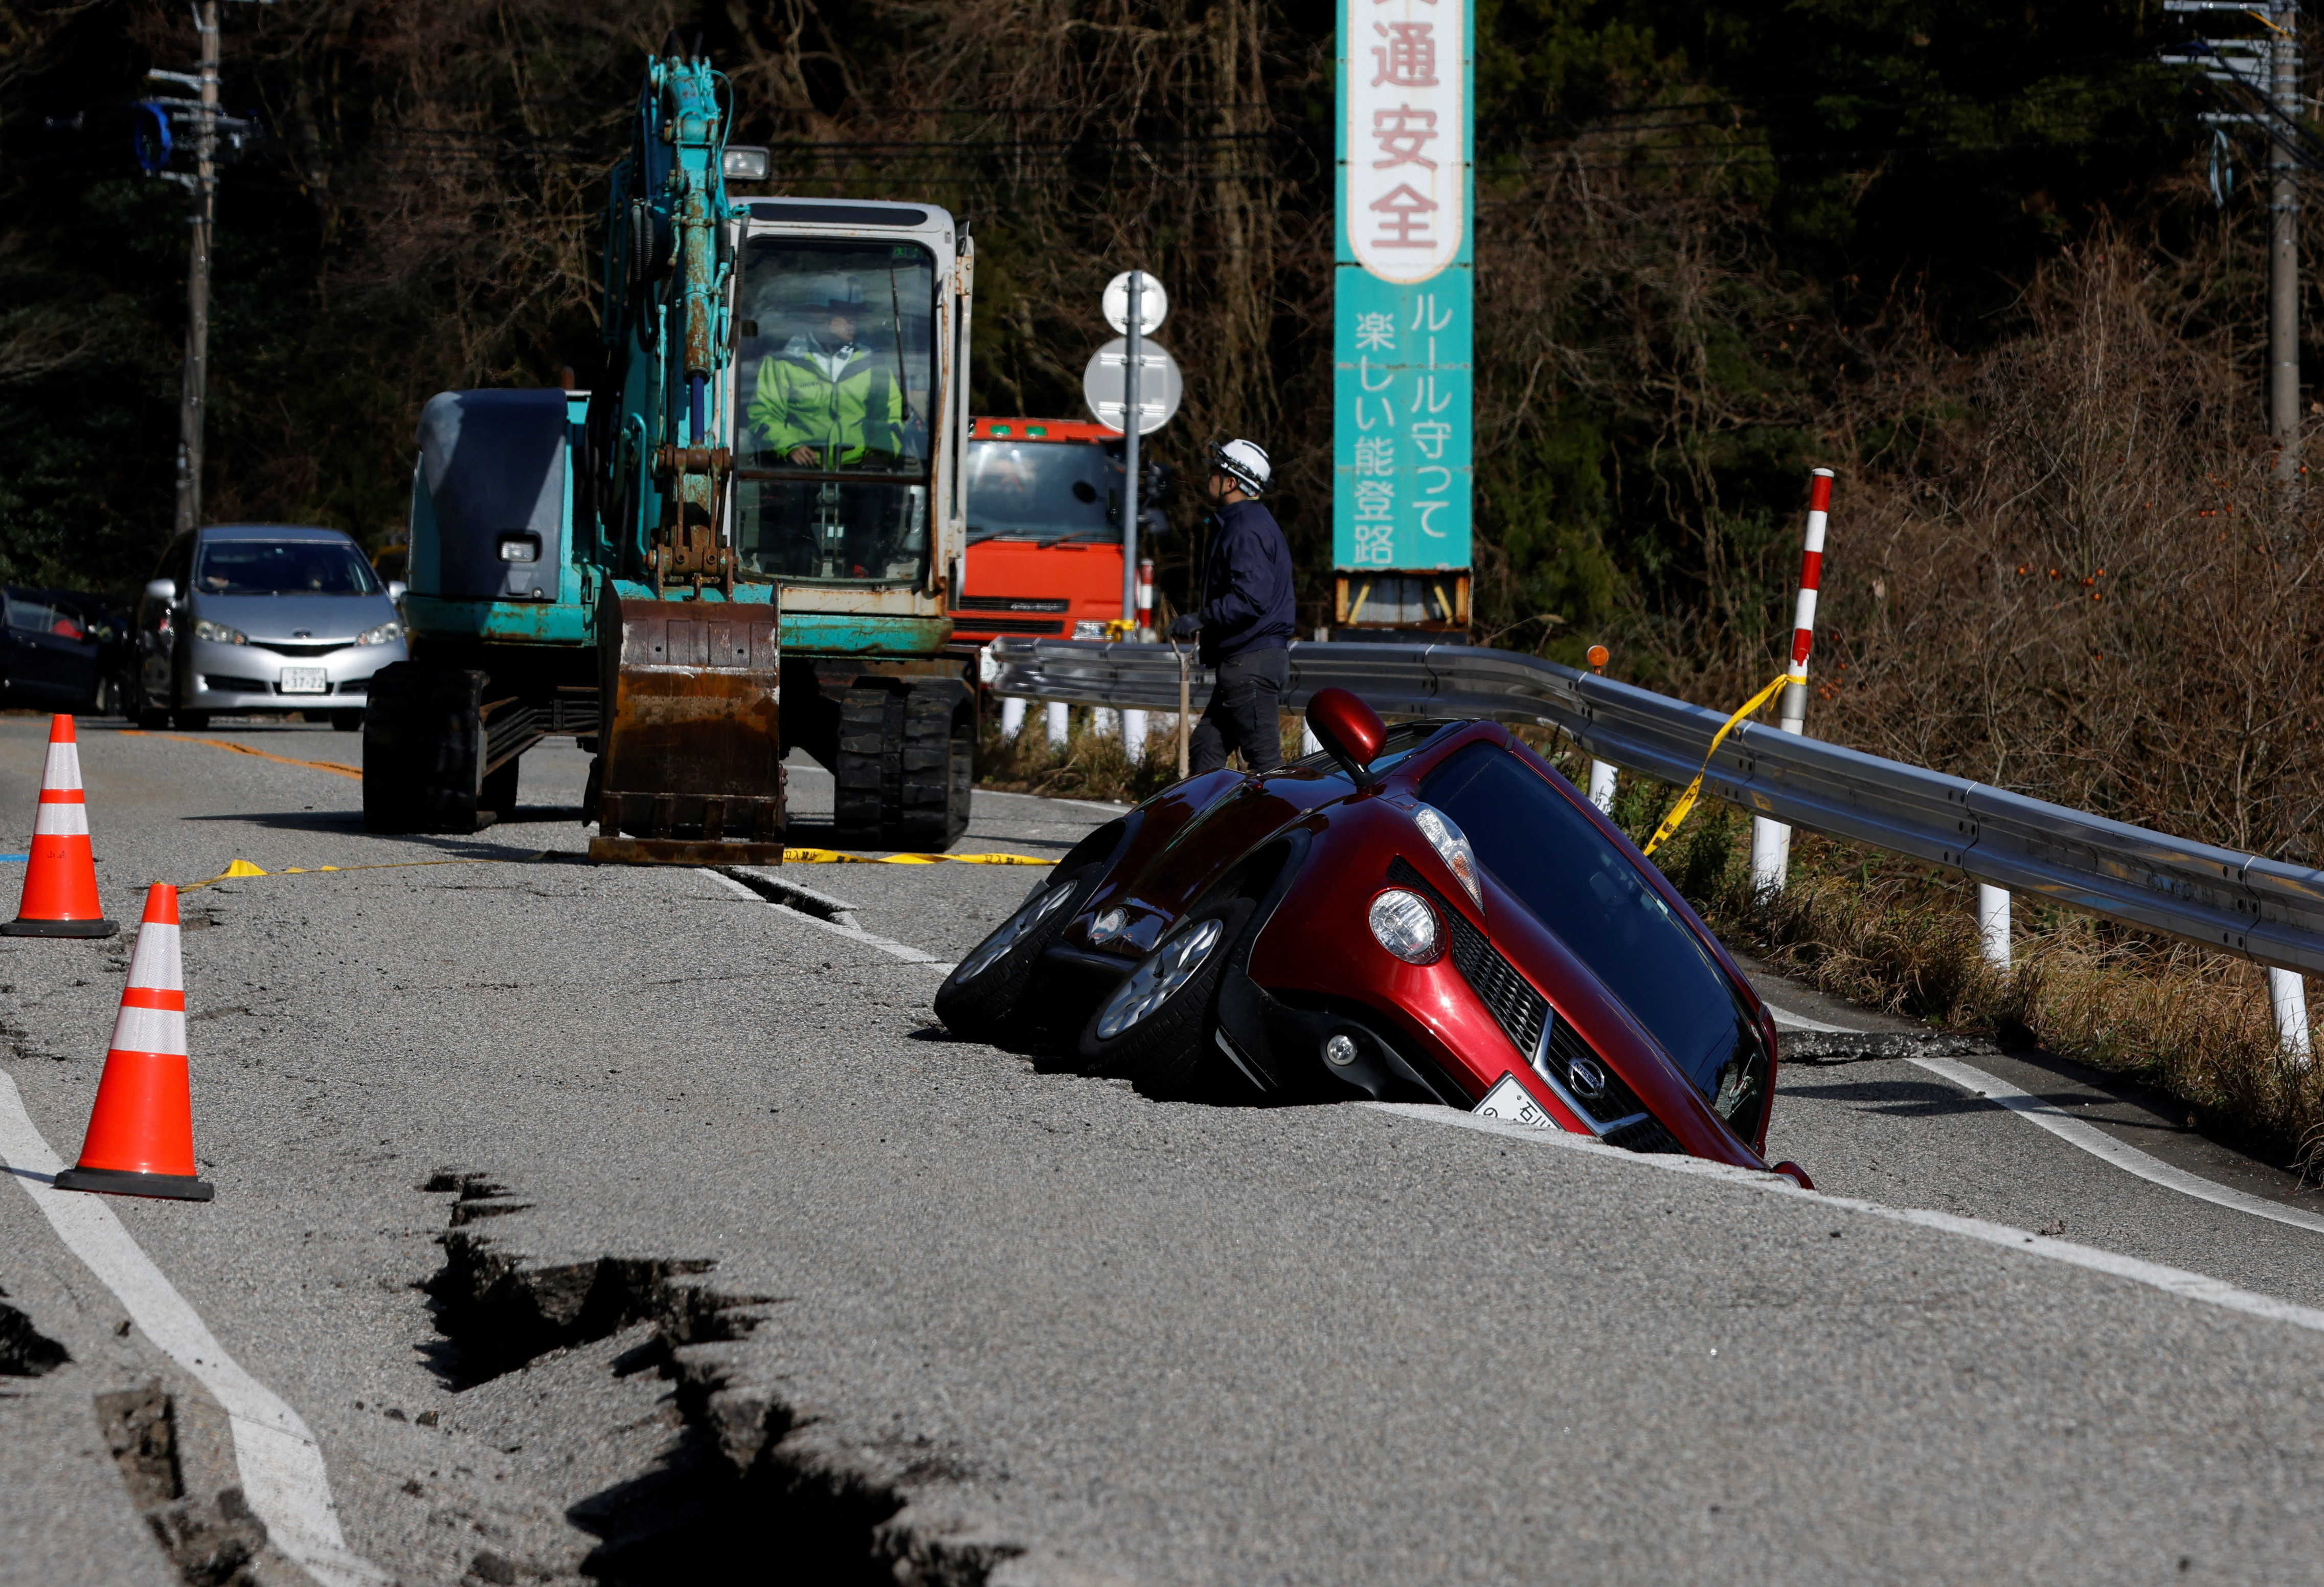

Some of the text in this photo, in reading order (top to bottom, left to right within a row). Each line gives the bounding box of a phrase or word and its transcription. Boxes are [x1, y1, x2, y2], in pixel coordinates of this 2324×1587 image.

[1370, 0, 1439, 249] 通安全
[1353, 312, 1396, 564] 楽しい能登路
[1411, 294, 1453, 538] ルール守って
[1574, 1062, 1602, 1092] NISSAN
